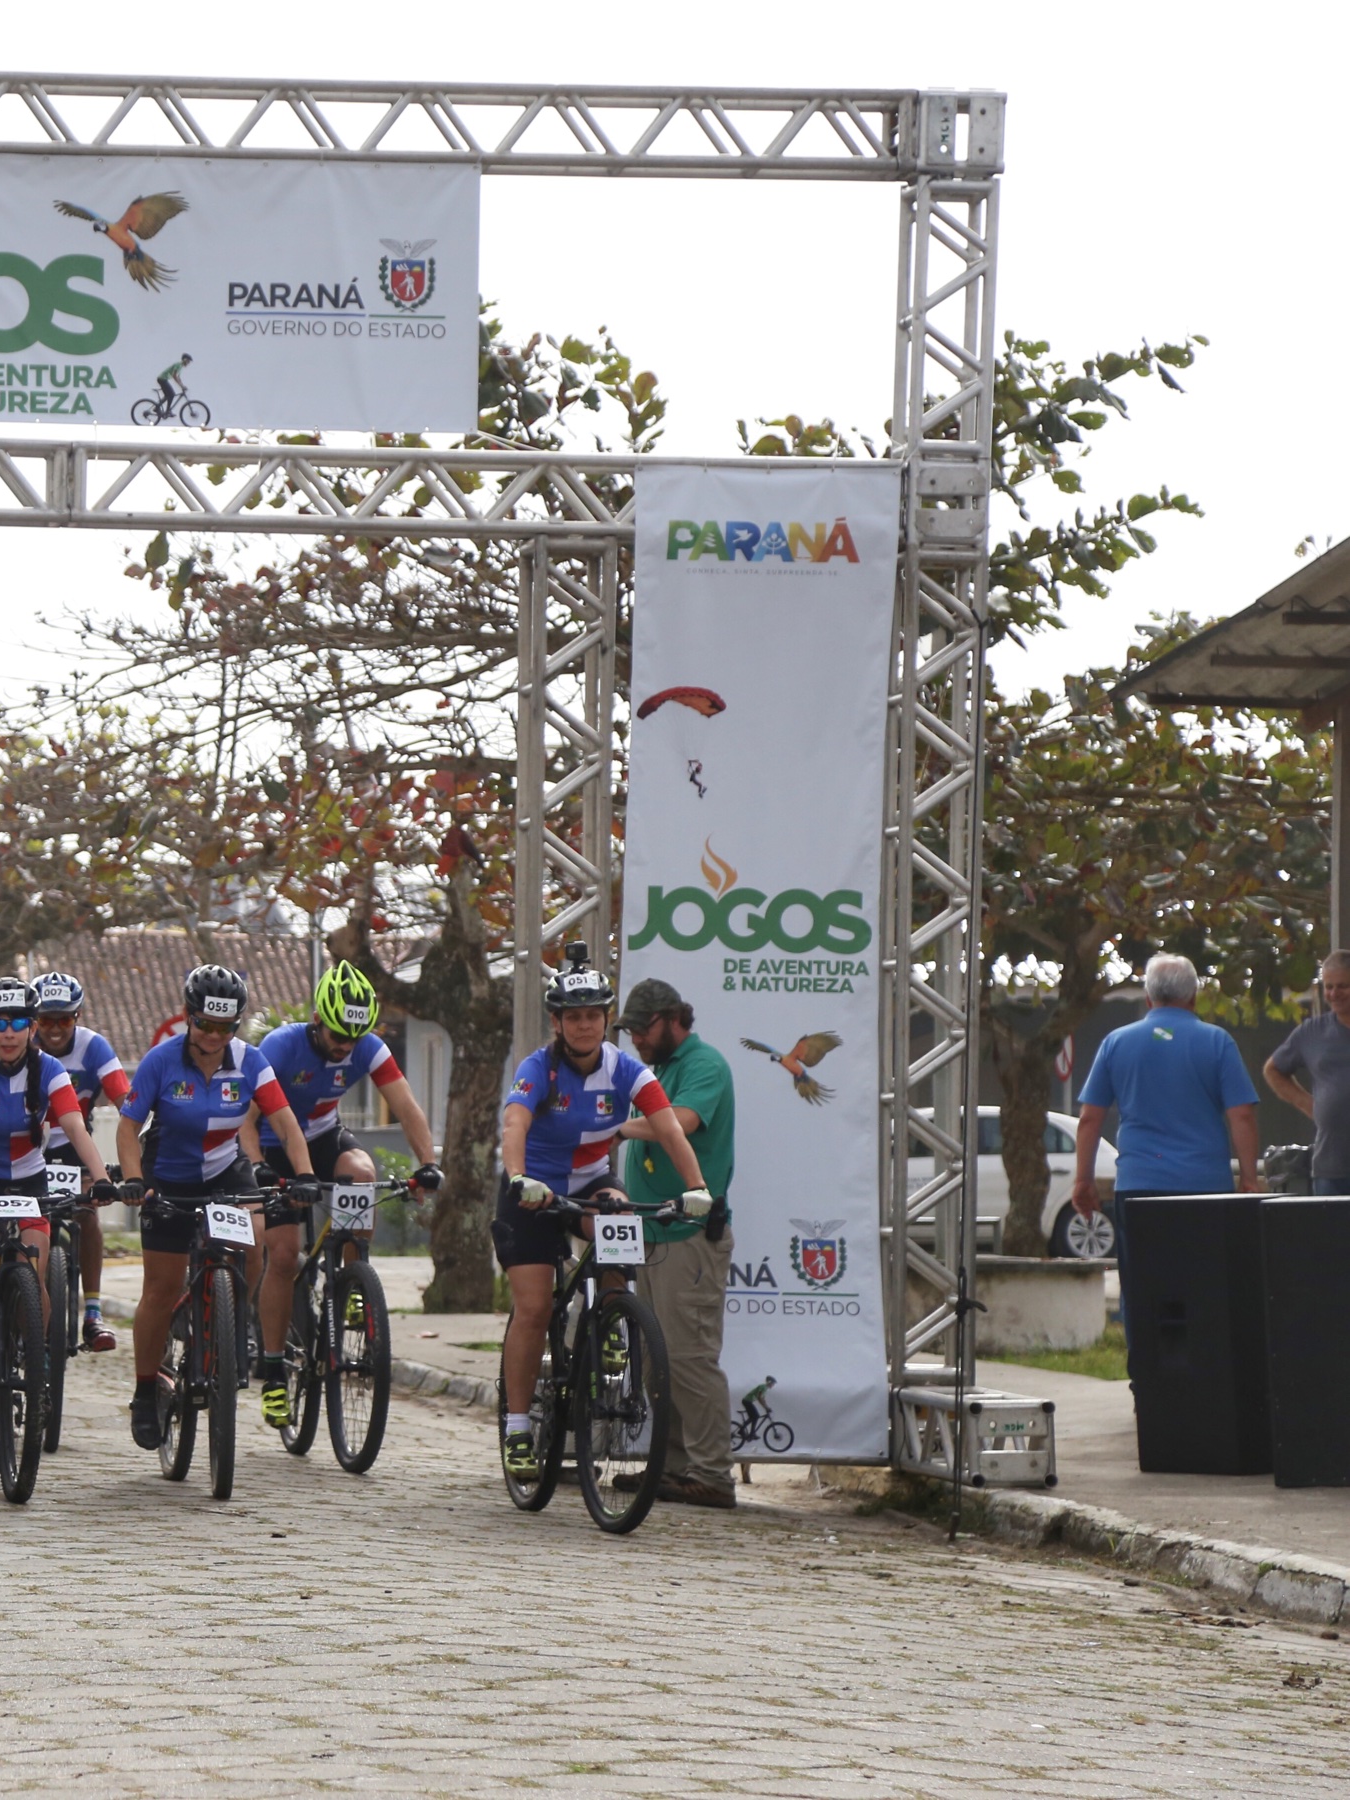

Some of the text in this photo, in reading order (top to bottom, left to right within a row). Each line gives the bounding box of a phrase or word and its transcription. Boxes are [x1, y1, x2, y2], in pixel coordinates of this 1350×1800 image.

[227, 278, 365, 311] PARANÁ
[226, 319, 447, 341] GOVERNO DO ESTADO
[666, 516, 861, 564] PARANÁ
[628, 884, 873, 955] JOGOS
[723, 958, 869, 977] DE AVENTURA
[568, 976, 588, 986] 051
[722, 975, 854, 993] & NATUREZA
[44, 988, 63, 997] 007
[207, 1001, 229, 1013] 055
[347, 1009, 365, 1019] 010
[46, 1171, 78, 1183] 007
[338, 1194, 370, 1209] 010
[212, 1210, 249, 1228] 055
[602, 1224, 637, 1241] 051
[747, 1299, 777, 1315] DO
[782, 1300, 861, 1317] ESTADO
[327, 1298, 336, 1348] manitou
